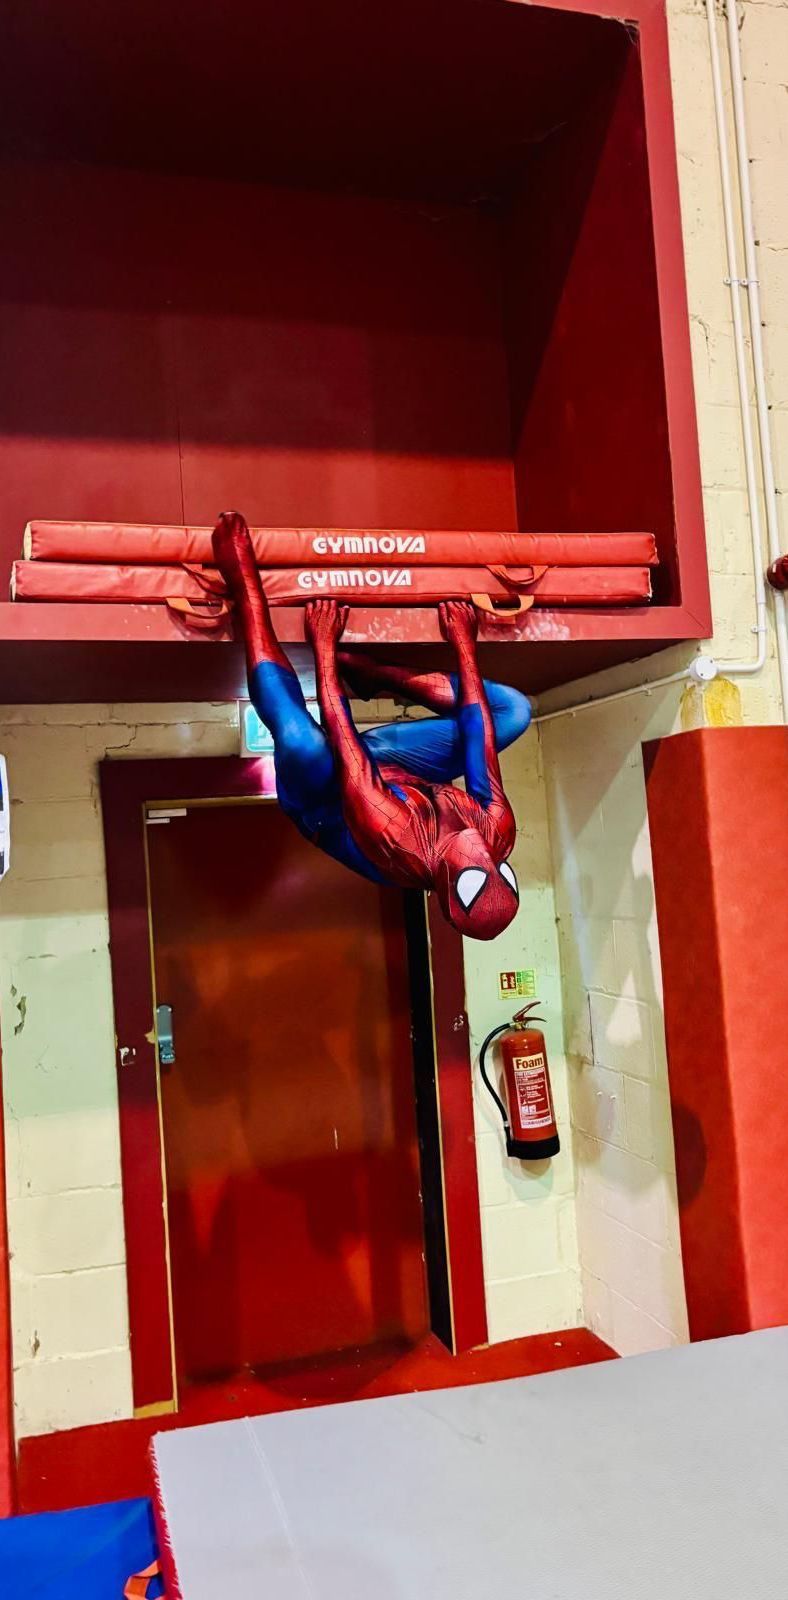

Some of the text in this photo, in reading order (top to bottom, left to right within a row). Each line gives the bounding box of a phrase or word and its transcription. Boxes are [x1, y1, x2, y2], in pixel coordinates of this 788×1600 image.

[312, 536, 426, 555] GYMNOVA
[297, 569, 412, 589] GYMNOVA
[515, 1057, 543, 1069] Foam
